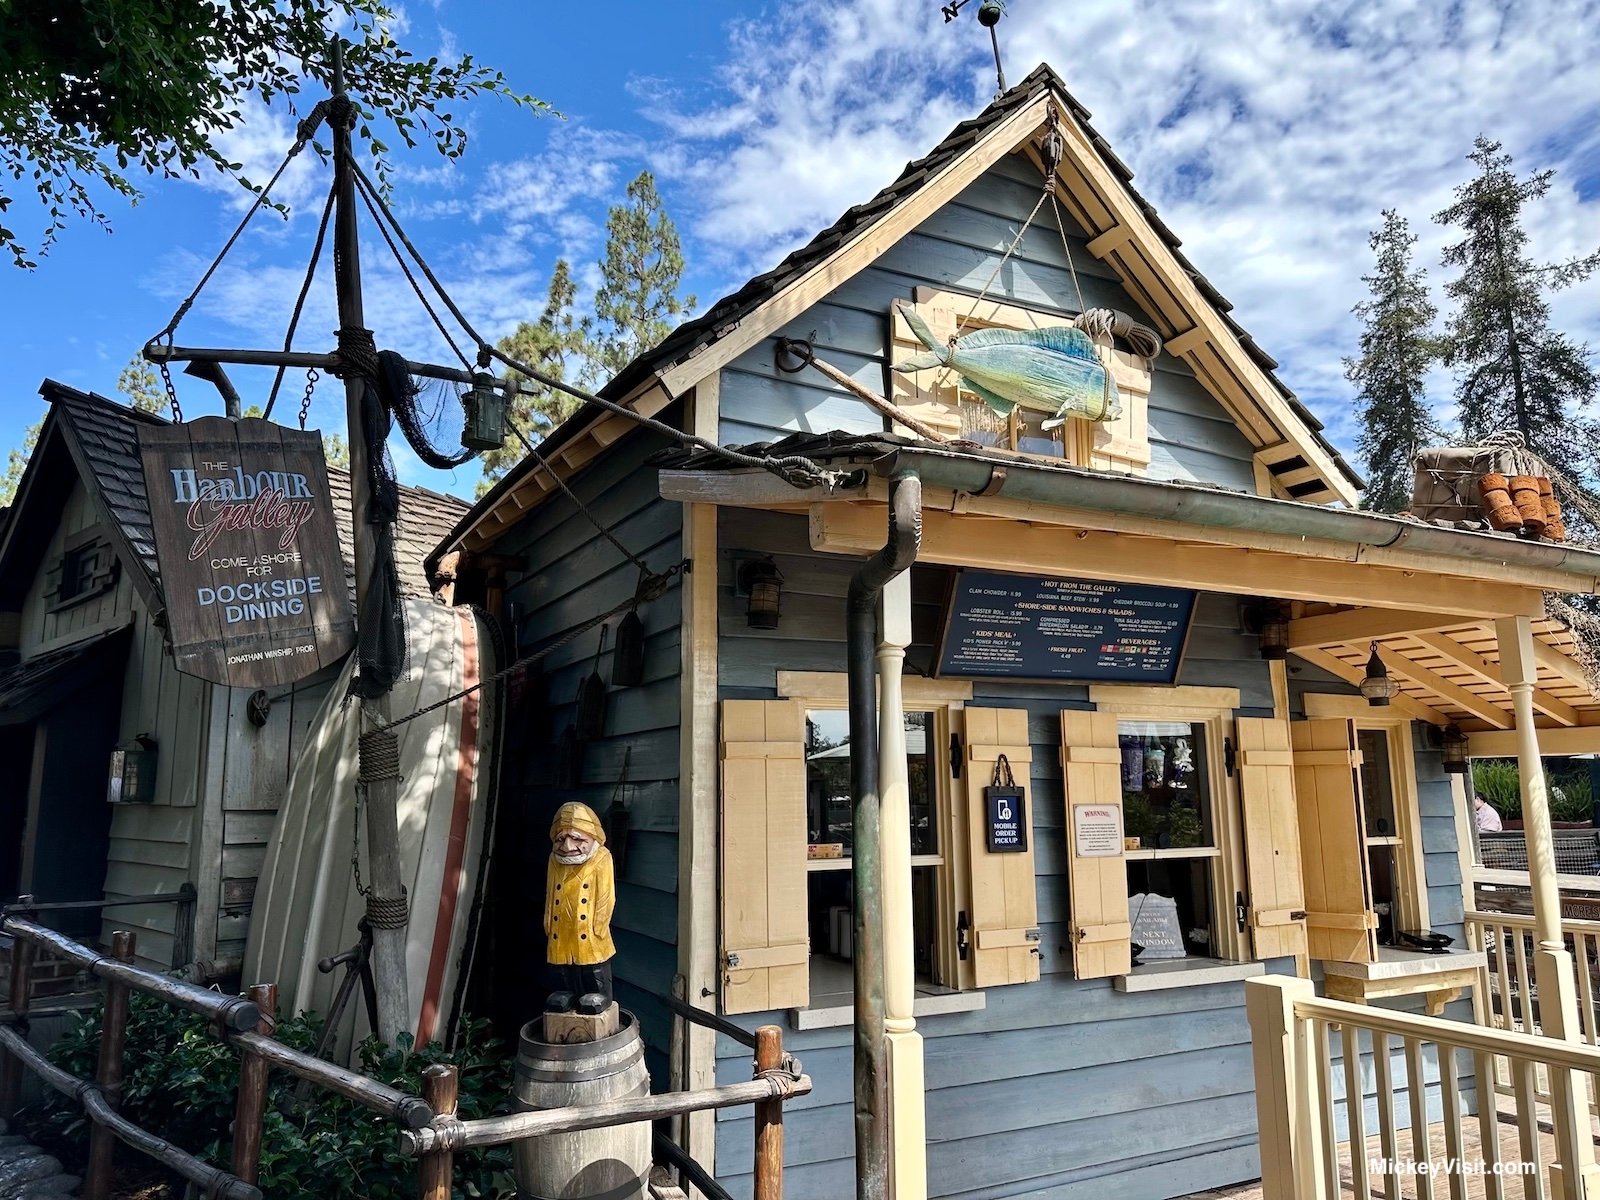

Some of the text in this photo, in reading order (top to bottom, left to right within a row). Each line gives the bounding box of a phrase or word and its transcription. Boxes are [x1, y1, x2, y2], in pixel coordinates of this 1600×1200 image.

[202, 461, 228, 471] THE
[186, 482, 315, 561] Galley
[211, 552, 302, 570] COME ASHORE
[246, 566, 272, 578] FOR
[197, 576, 322, 606] DOCKSIDE
[1093, 584, 1118, 592] GALLEY
[225, 598, 304, 624] DINING
[1018, 602, 1058, 610] SHORE-SIDE
[1058, 605, 1101, 614] SANDWICHES
[1108, 608, 1132, 616] SALADS
[227, 644, 315, 665] JONATHAN WINSHIP, PROP.
[1564, 904, 1592, 918] MORE
